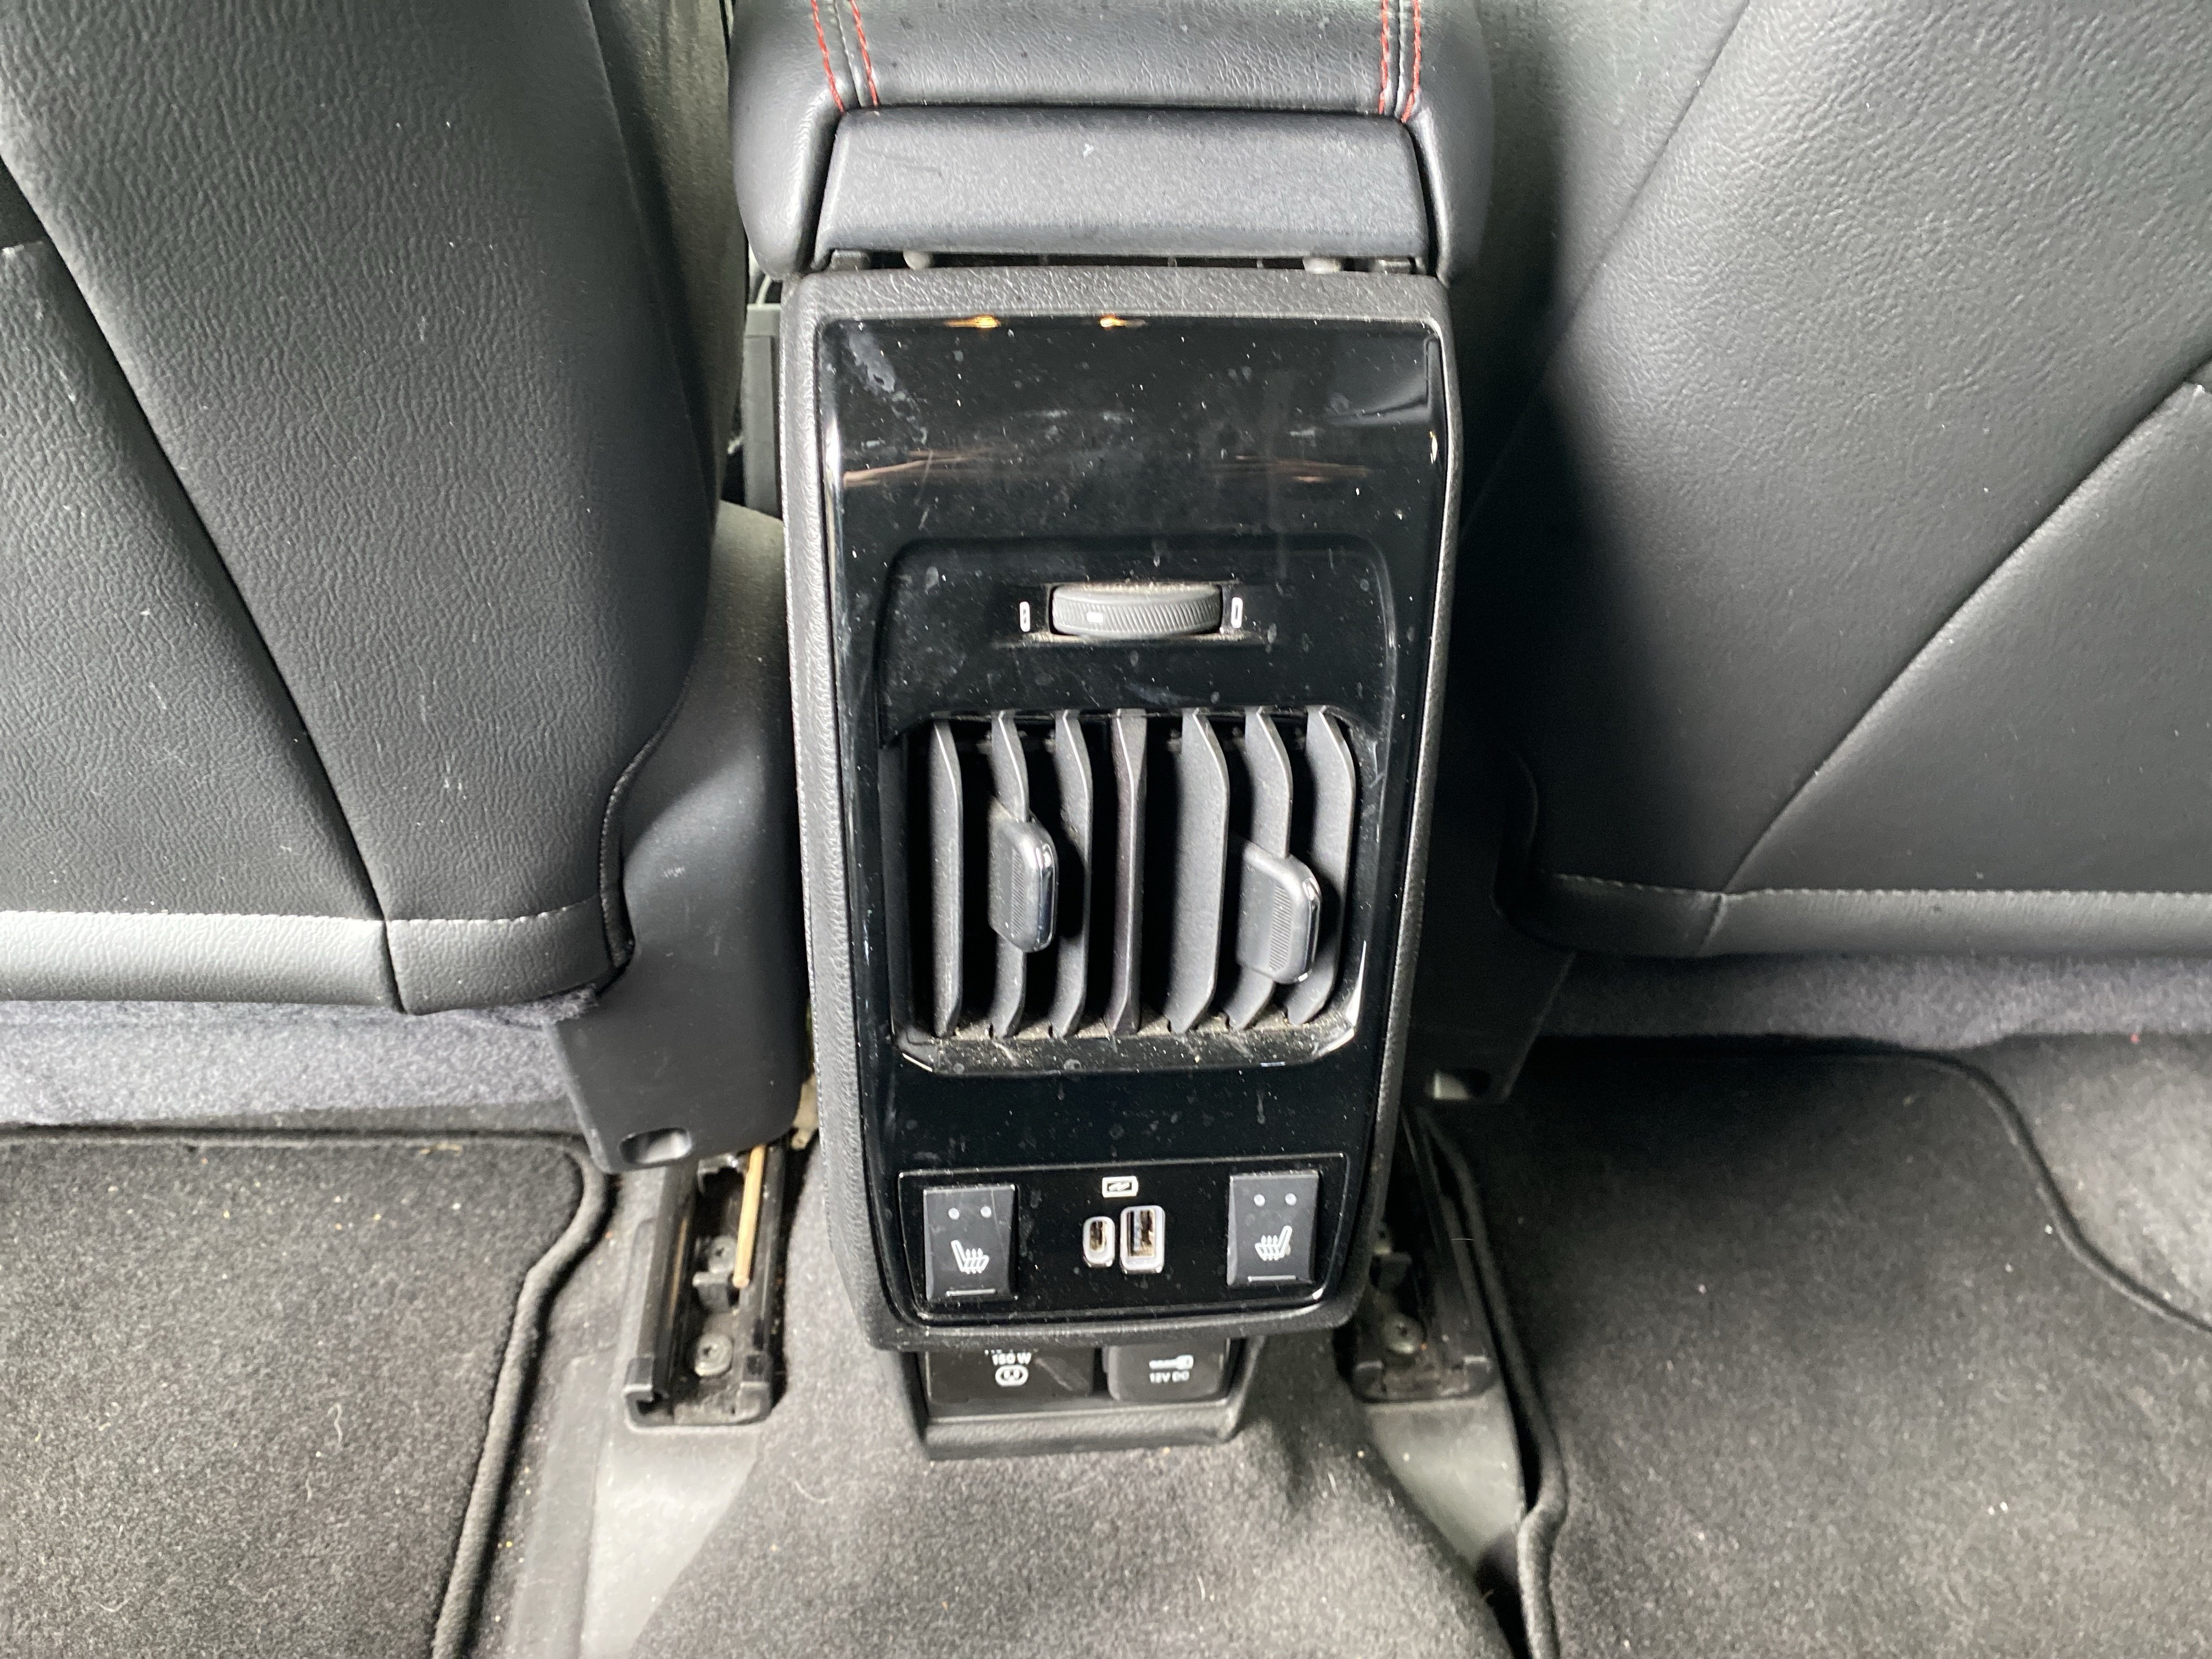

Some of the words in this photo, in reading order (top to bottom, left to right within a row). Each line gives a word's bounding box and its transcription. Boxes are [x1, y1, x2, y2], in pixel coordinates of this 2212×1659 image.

[992, 1353, 1015, 1365] 150
[1017, 1352, 1031, 1364] W
[1150, 1372, 1171, 1383] 12V
